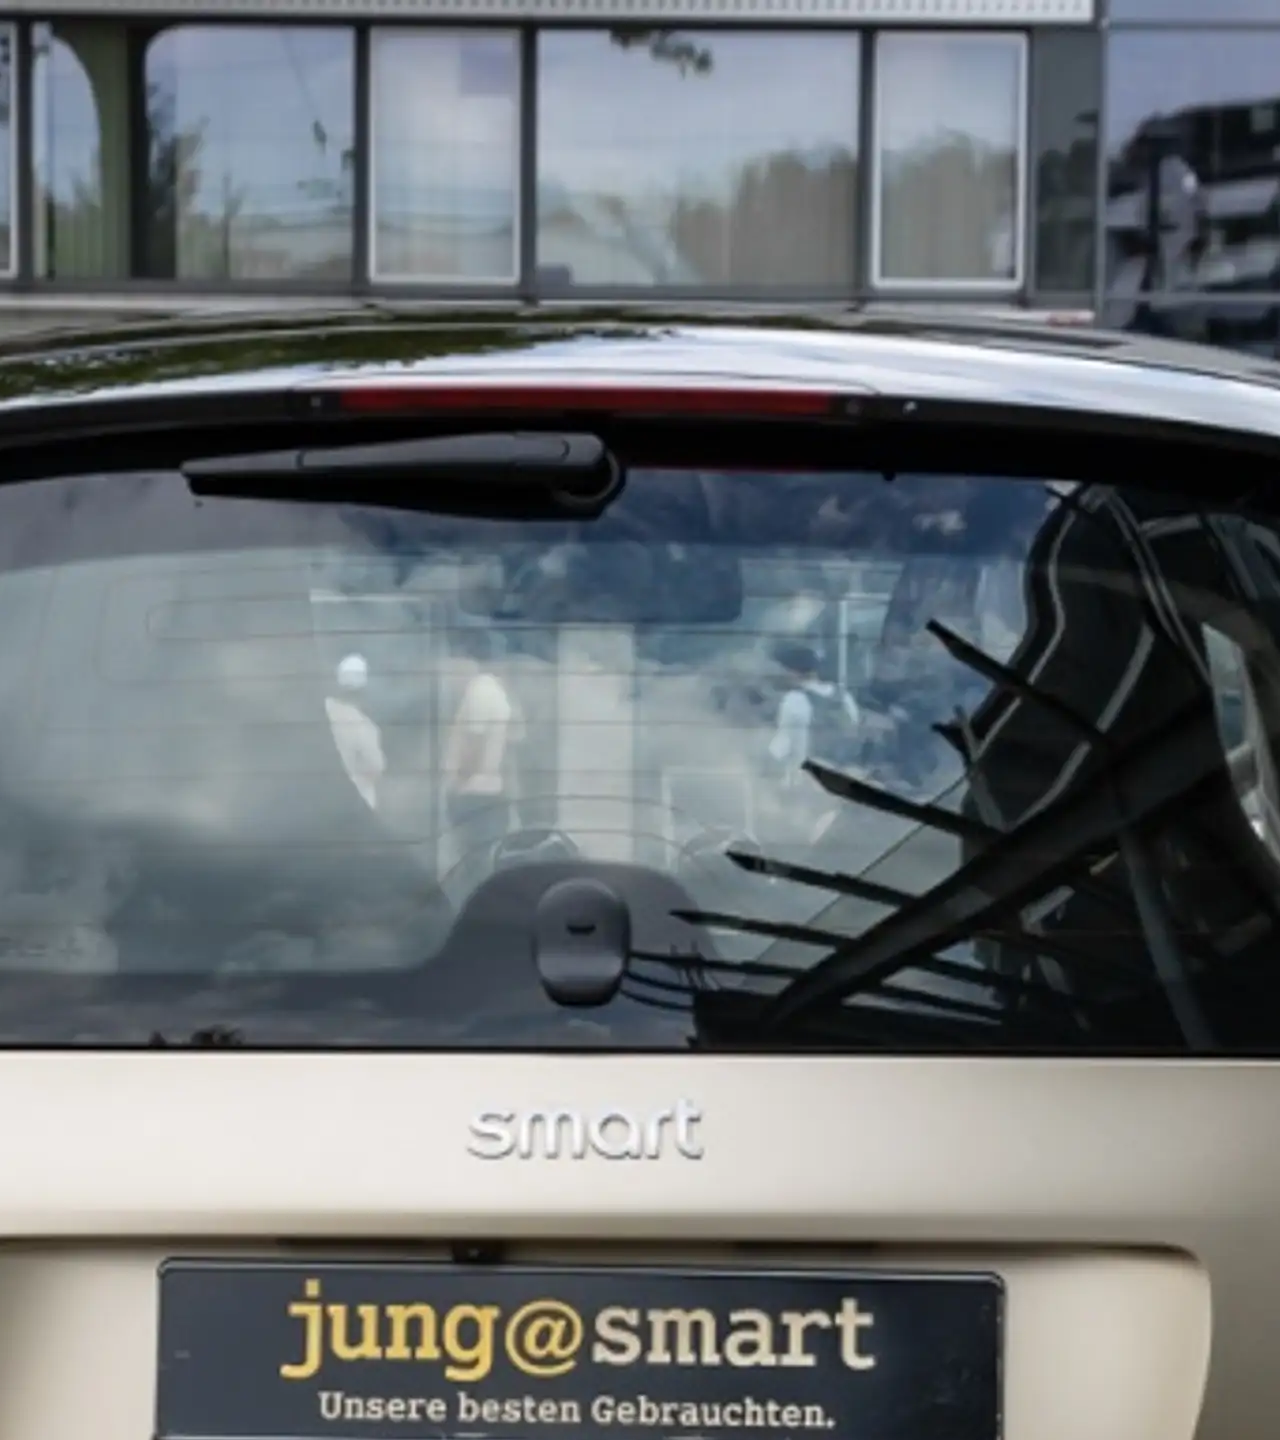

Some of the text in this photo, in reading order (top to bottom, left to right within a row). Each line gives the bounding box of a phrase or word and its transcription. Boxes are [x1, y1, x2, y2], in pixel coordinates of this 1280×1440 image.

[467, 1097, 705, 1161] smart
[318, 1391, 837, 1429] Unsere besten Gebrauchten.
